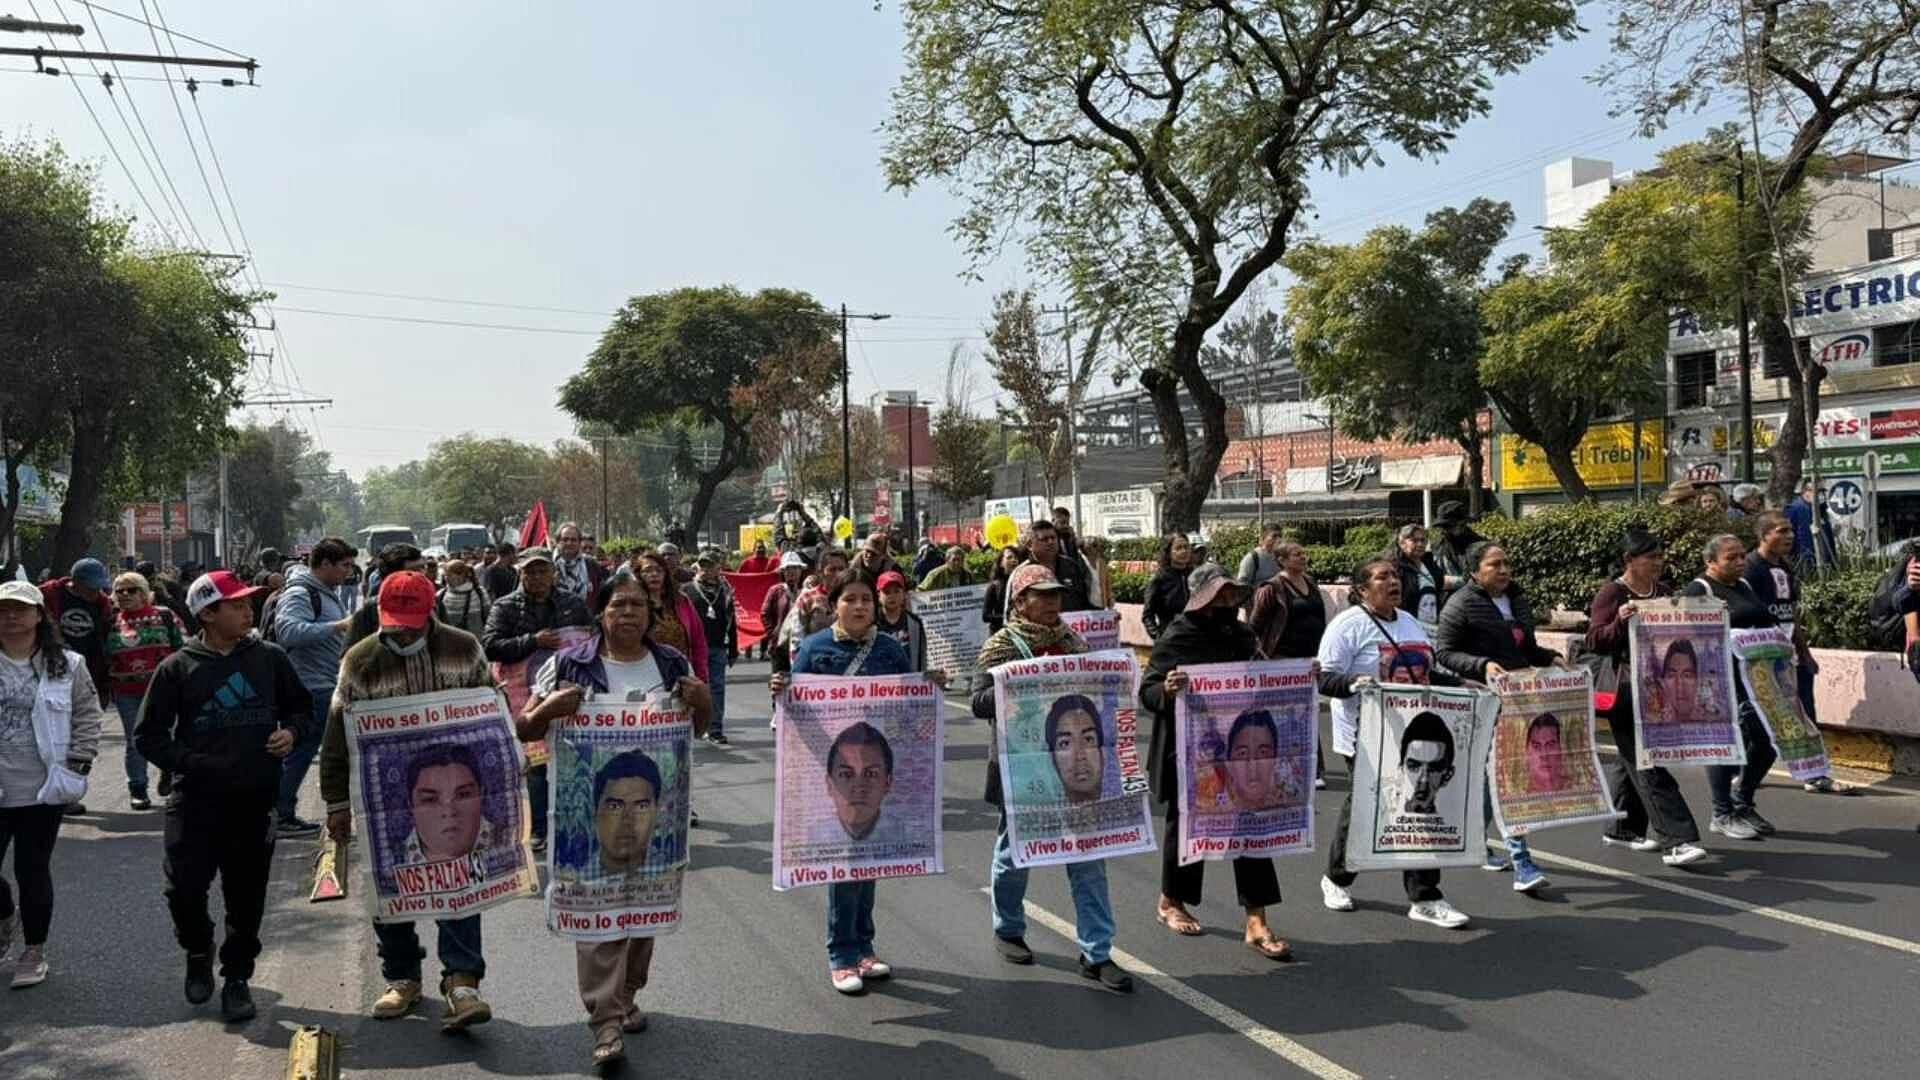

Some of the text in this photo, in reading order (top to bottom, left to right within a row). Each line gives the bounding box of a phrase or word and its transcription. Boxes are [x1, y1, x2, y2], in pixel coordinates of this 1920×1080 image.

[1822, 342, 1861, 362] LTH
[1830, 486, 1861, 509] 46
[1072, 616, 1117, 633] sticia!
[1006, 657, 1132, 680] ¡Vivo se lo llevaron!
[788, 681, 933, 703] ¡Vivo se lo llevaron!
[1190, 671, 1312, 694] ¡Vivo se lo llevaron!
[359, 713, 395, 734] ¡Vivo
[400, 712, 420, 726] se
[425, 707, 440, 722] lo
[595, 713, 615, 726] se
[621, 710, 637, 726] lo
[1118, 709, 1137, 733] NOS
[1024, 827, 1141, 859] ¡Vivo lo queremos!
[1193, 838, 1225, 854] ¡Vivo
[1228, 838, 1240, 850] lo
[396, 867, 426, 895] NOS
[790, 859, 927, 886] ¡Vivo lo queremos!
[389, 874, 523, 915] ¡Vivo lo queremos!
[557, 911, 591, 930] ¡Vivo
[596, 912, 612, 929] lo
